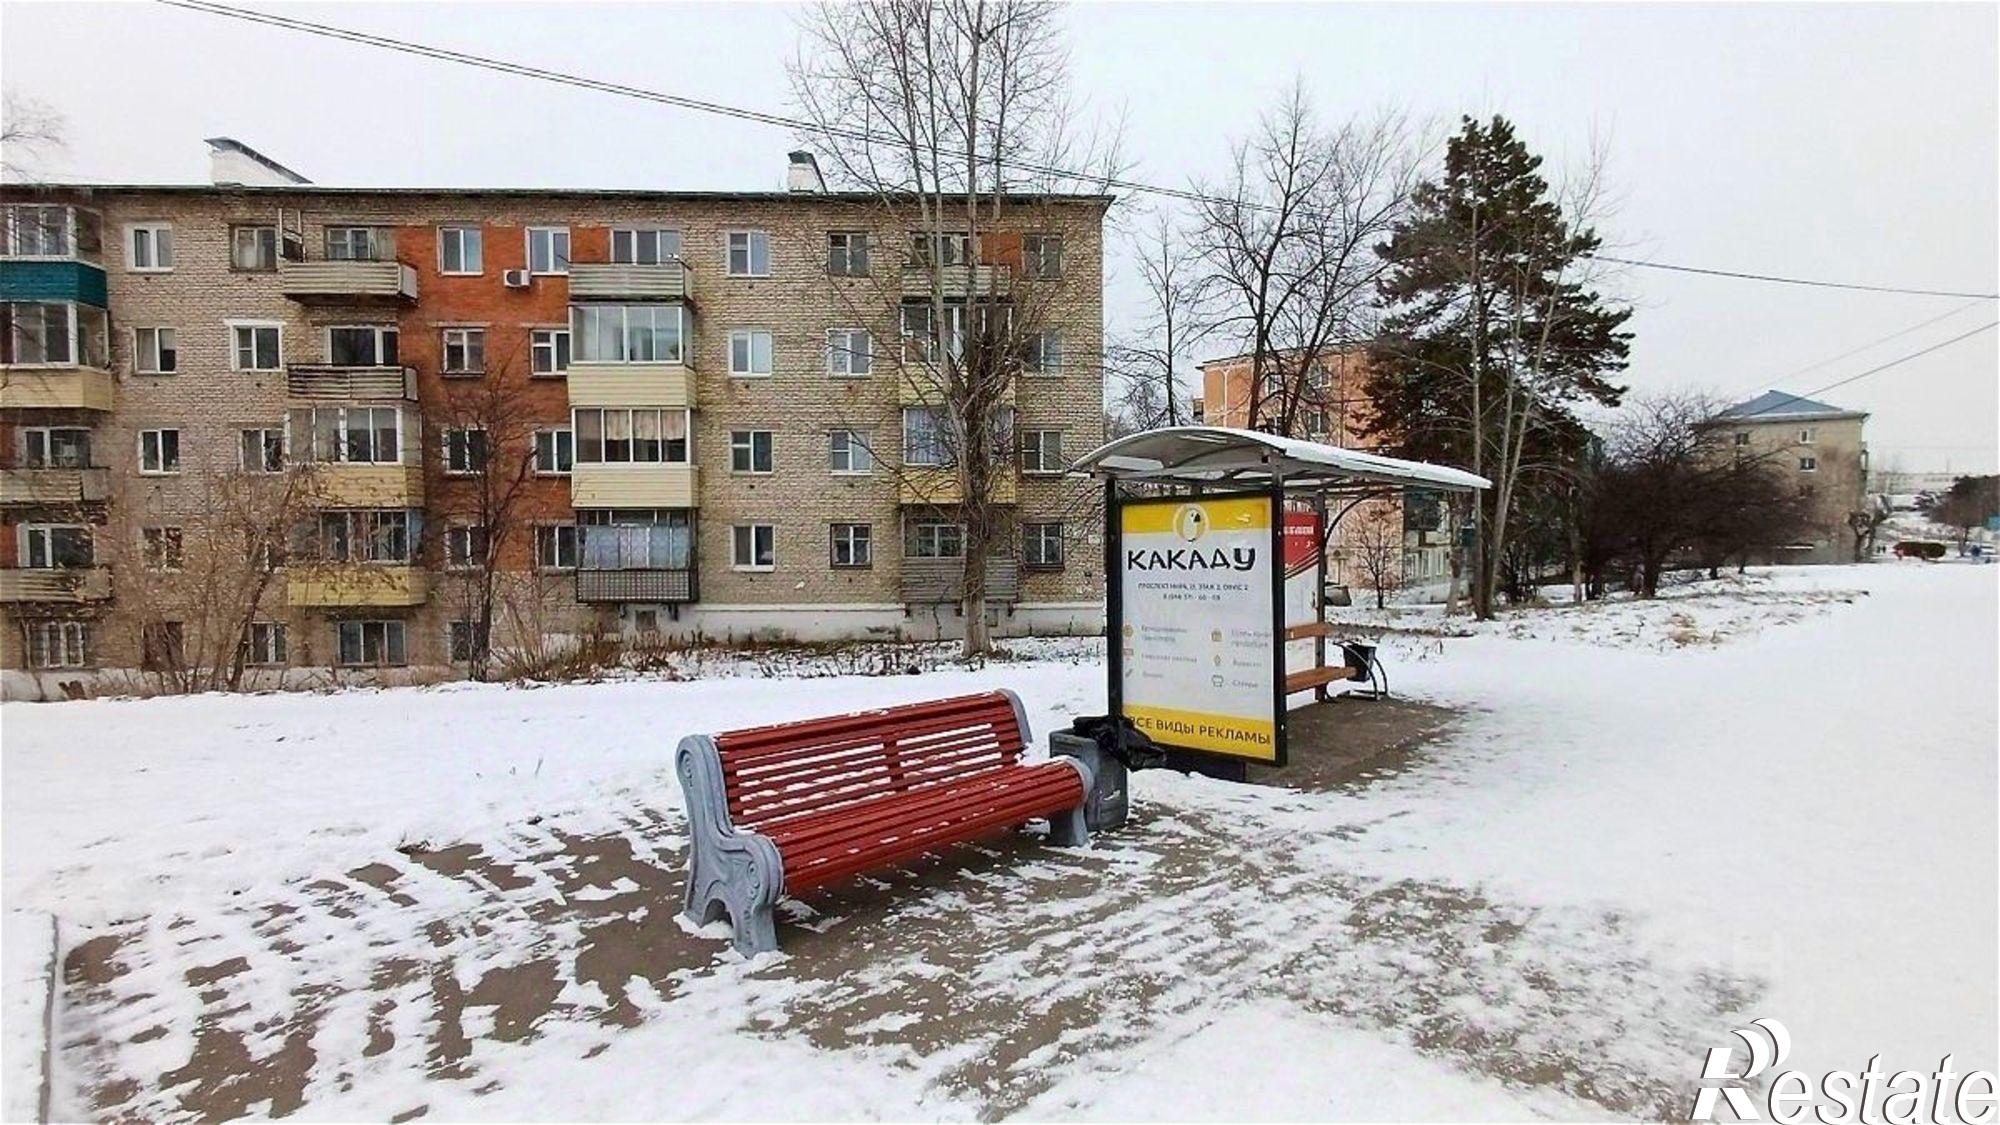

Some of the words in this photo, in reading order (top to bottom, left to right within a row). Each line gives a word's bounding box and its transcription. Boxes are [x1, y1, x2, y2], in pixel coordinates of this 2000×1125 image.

[1127, 547, 1256, 571] КАКАДУ
[1156, 719, 1194, 734] ВИДЫ
[1199, 725, 1271, 745] РЕКЛАМЫ
